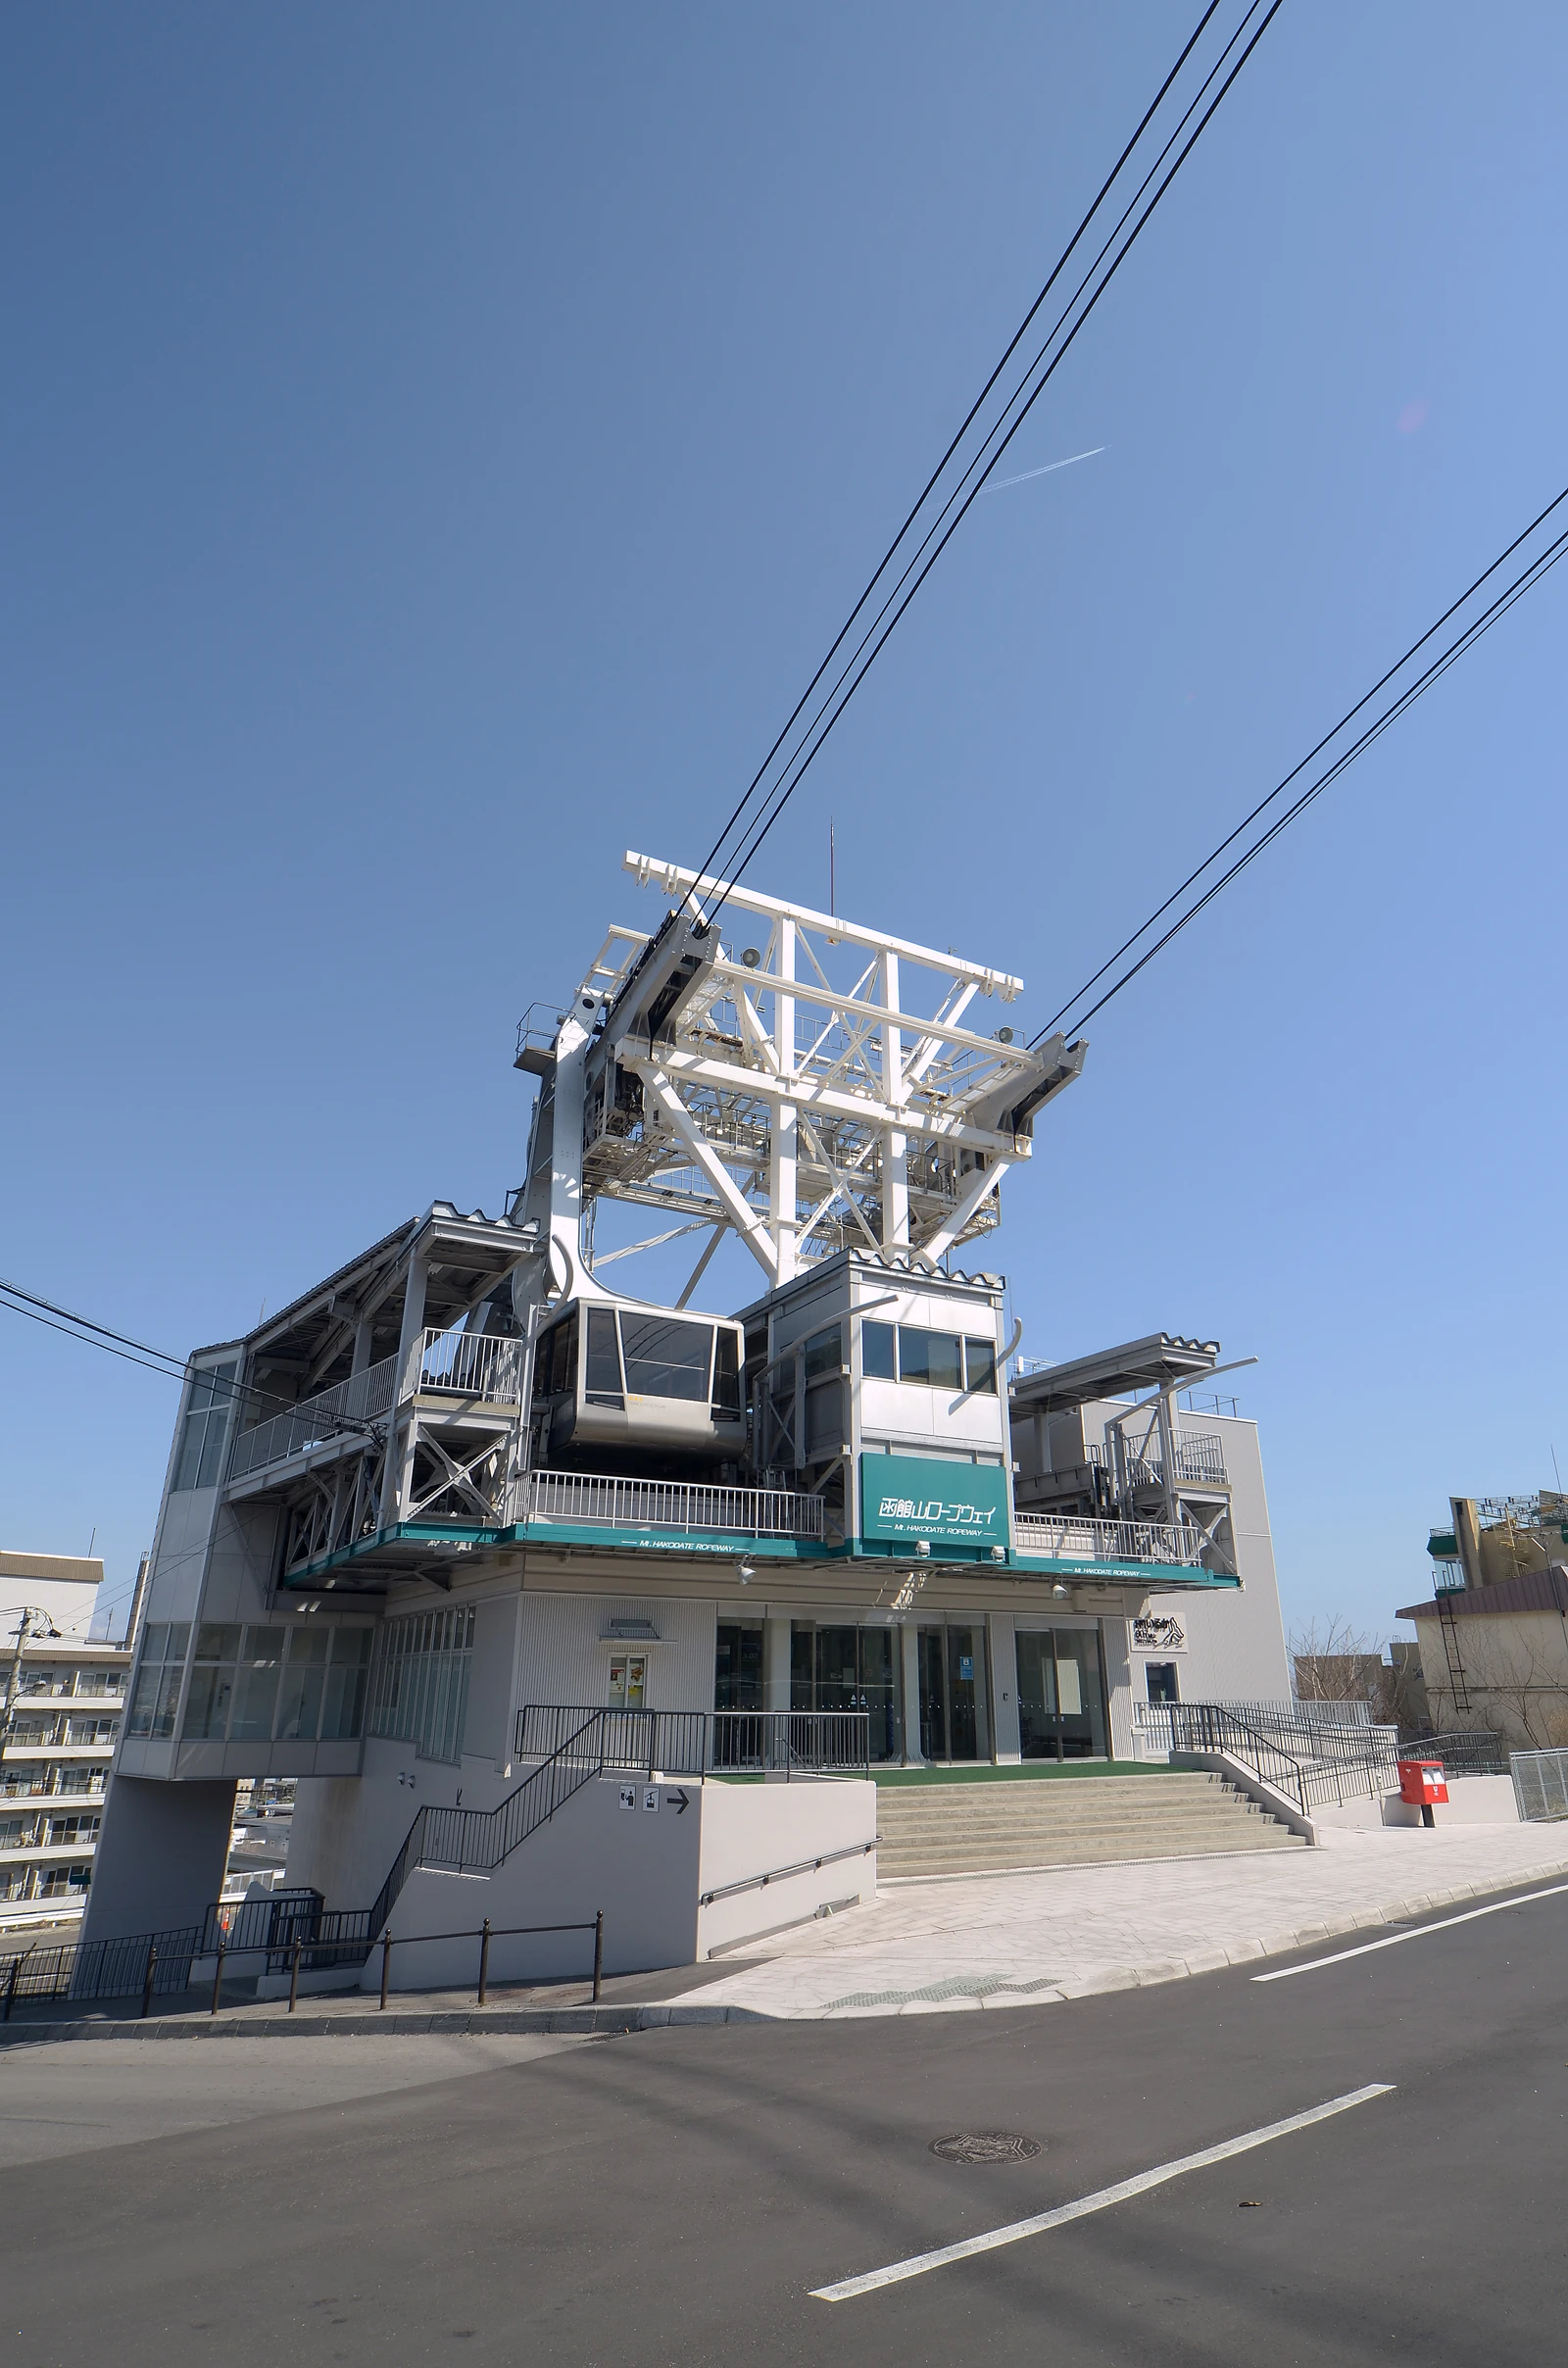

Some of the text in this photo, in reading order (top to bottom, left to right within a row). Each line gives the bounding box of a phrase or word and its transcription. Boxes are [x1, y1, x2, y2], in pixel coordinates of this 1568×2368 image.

[878, 1497, 997, 1524] 函館山ロープウェイ
[907, 1524, 946, 1534] HAKODATE
[947, 1526, 983, 1536] ROPEWAY
[653, 1541, 694, 1550] HAKODATE
[695, 1543, 735, 1552] ROPEWAY
